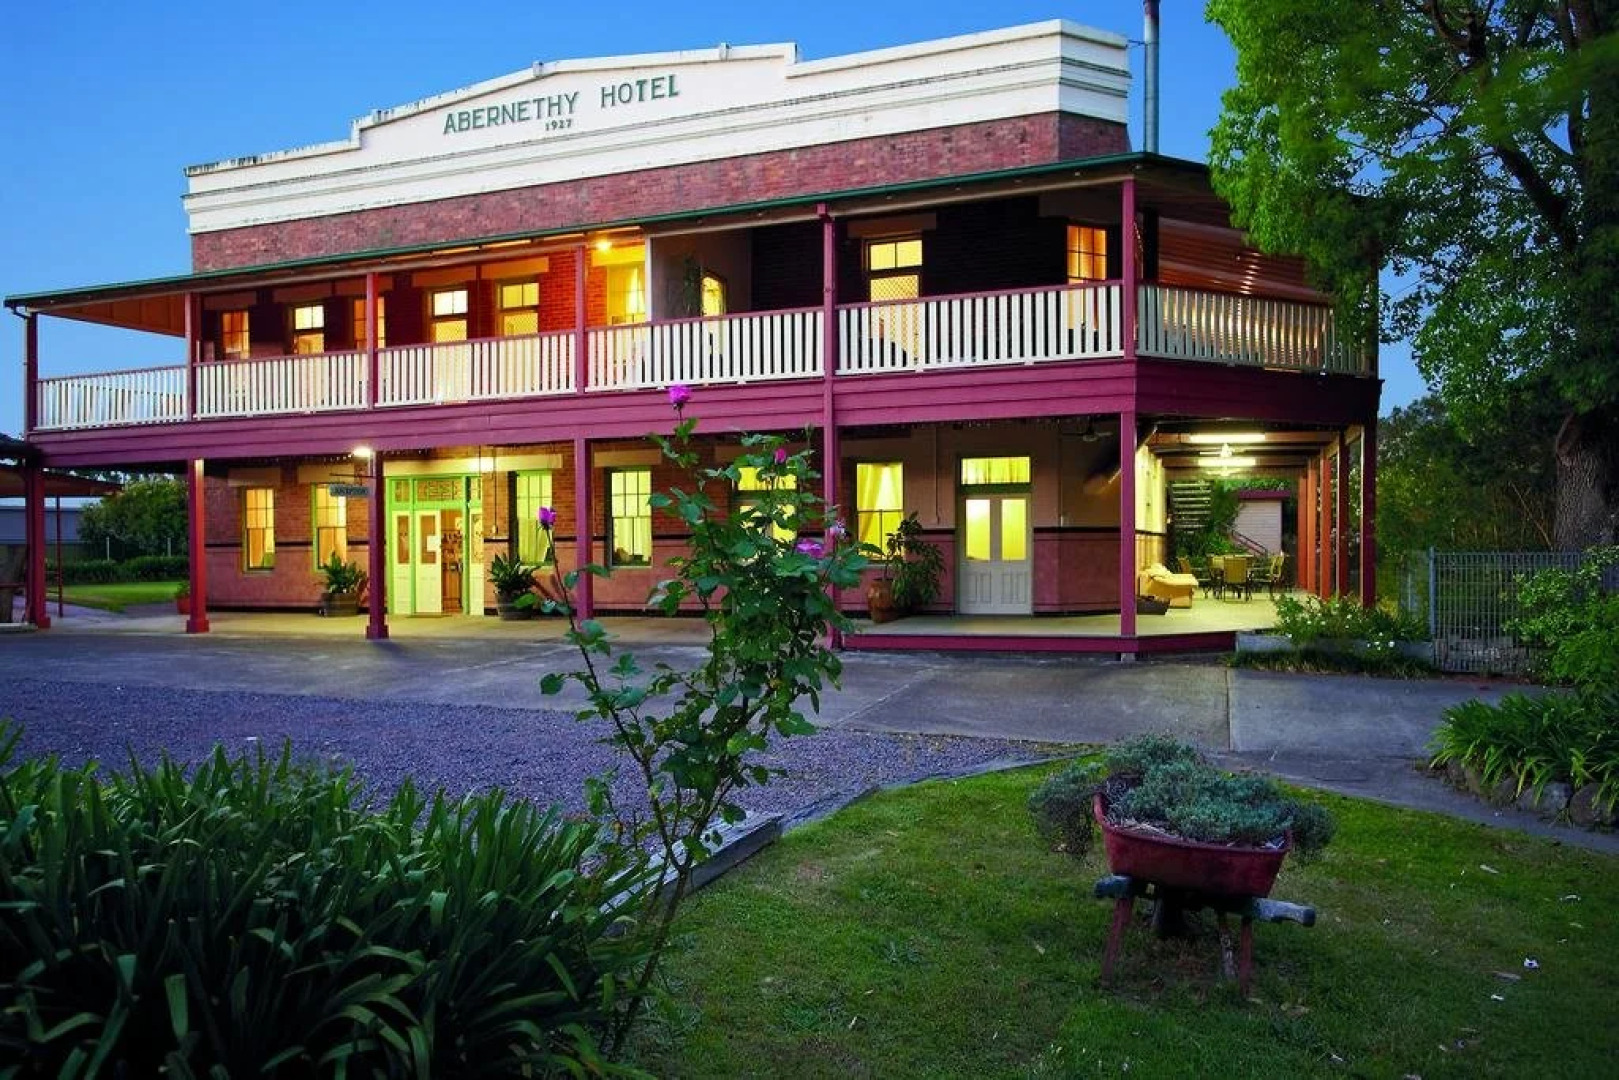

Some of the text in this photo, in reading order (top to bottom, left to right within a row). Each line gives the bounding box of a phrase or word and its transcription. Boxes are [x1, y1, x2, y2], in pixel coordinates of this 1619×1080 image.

[443, 74, 681, 134] ABERNETHY HOTEL
[545, 118, 572, 132] 1927
